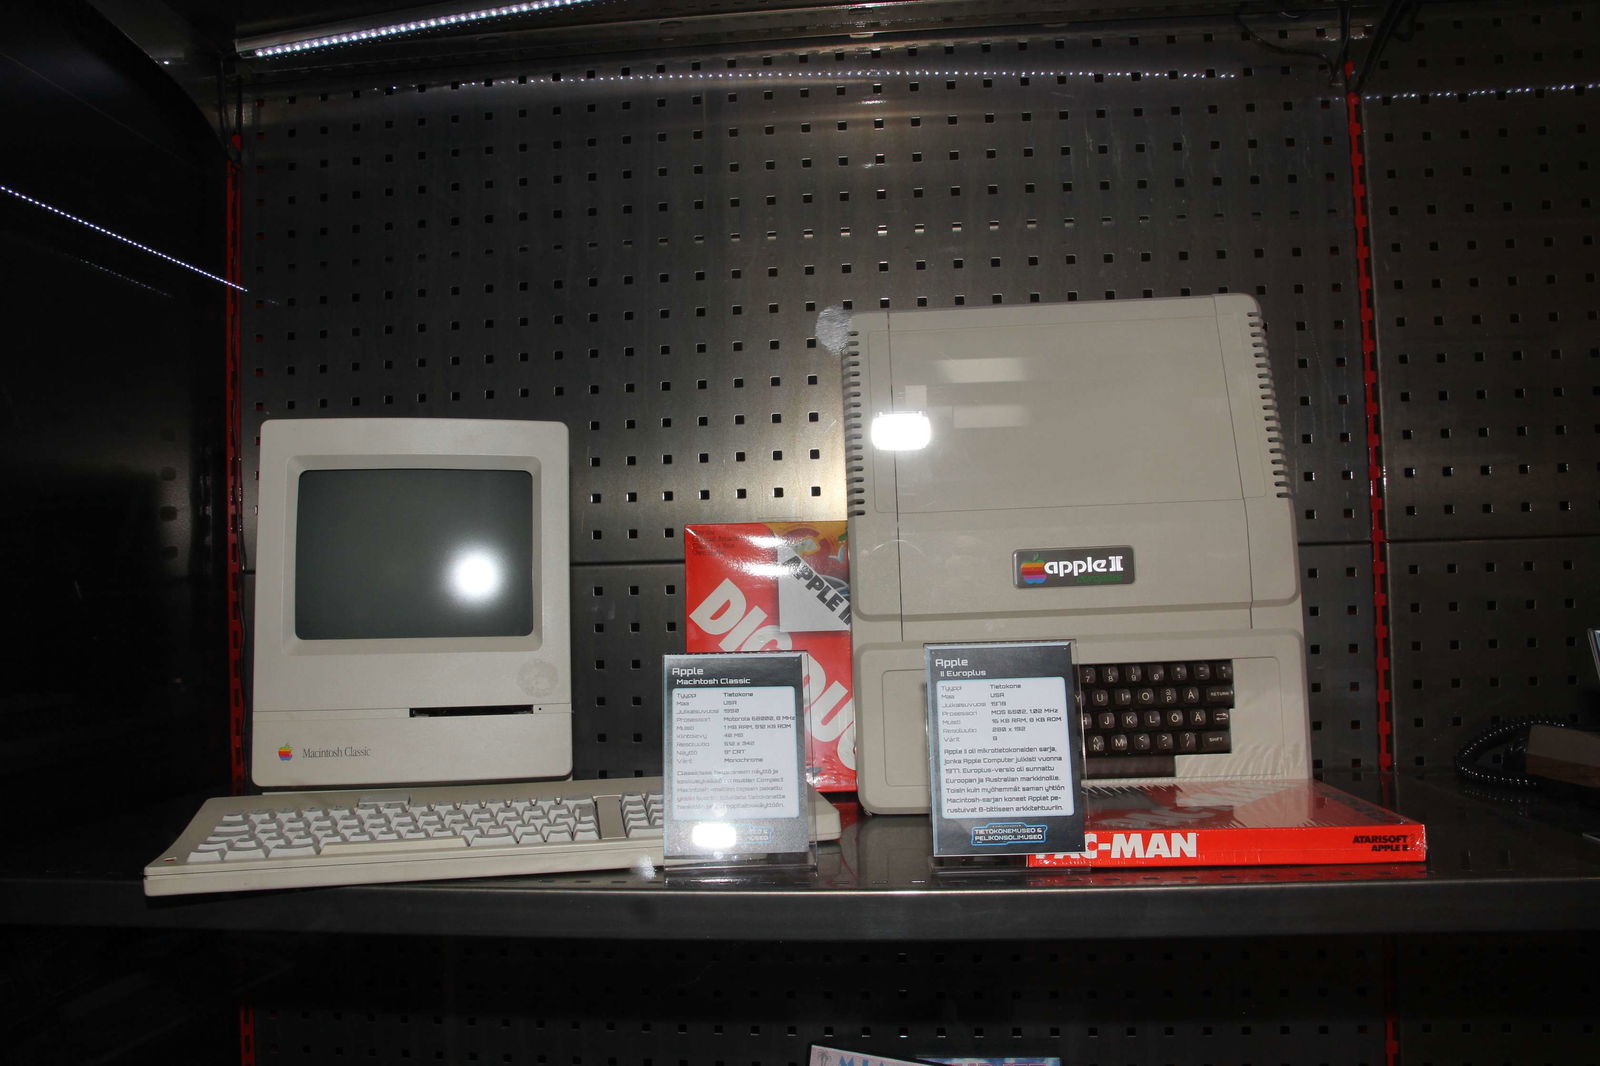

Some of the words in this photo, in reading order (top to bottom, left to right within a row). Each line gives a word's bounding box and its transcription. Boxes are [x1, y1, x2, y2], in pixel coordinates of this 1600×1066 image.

[1044, 556, 1107, 577] apple
[935, 657, 969, 668] Apple
[672, 667, 704, 677] Apple
[946, 669, 987, 678] Europlus
[720, 677, 751, 685] Classic
[1131, 674, 1137, 682] 9
[1096, 693, 1104, 702] U
[1141, 692, 1150, 701] O
[1104, 716, 1110, 725] J
[1125, 715, 1133, 724] K
[1149, 715, 1156, 724] L
[1171, 712, 1179, 723] Ö
[1194, 711, 1202, 722] Ä
[1114, 738, 1124, 747] M
[302, 747, 343, 759] Macintosh
[344, 746, 370, 757] Classic
[943, 758, 962, 766] jonka
[981, 786, 1021, 794] myöhemmät
[1045, 784, 1065, 792] yhtiön
[974, 827, 1035, 835] TIETOKONEMUSEO
[1353, 834, 1407, 844] ATARISOFT
[1035, 832, 1197, 859] C-MAN
[1371, 844, 1400, 852] APPLE
